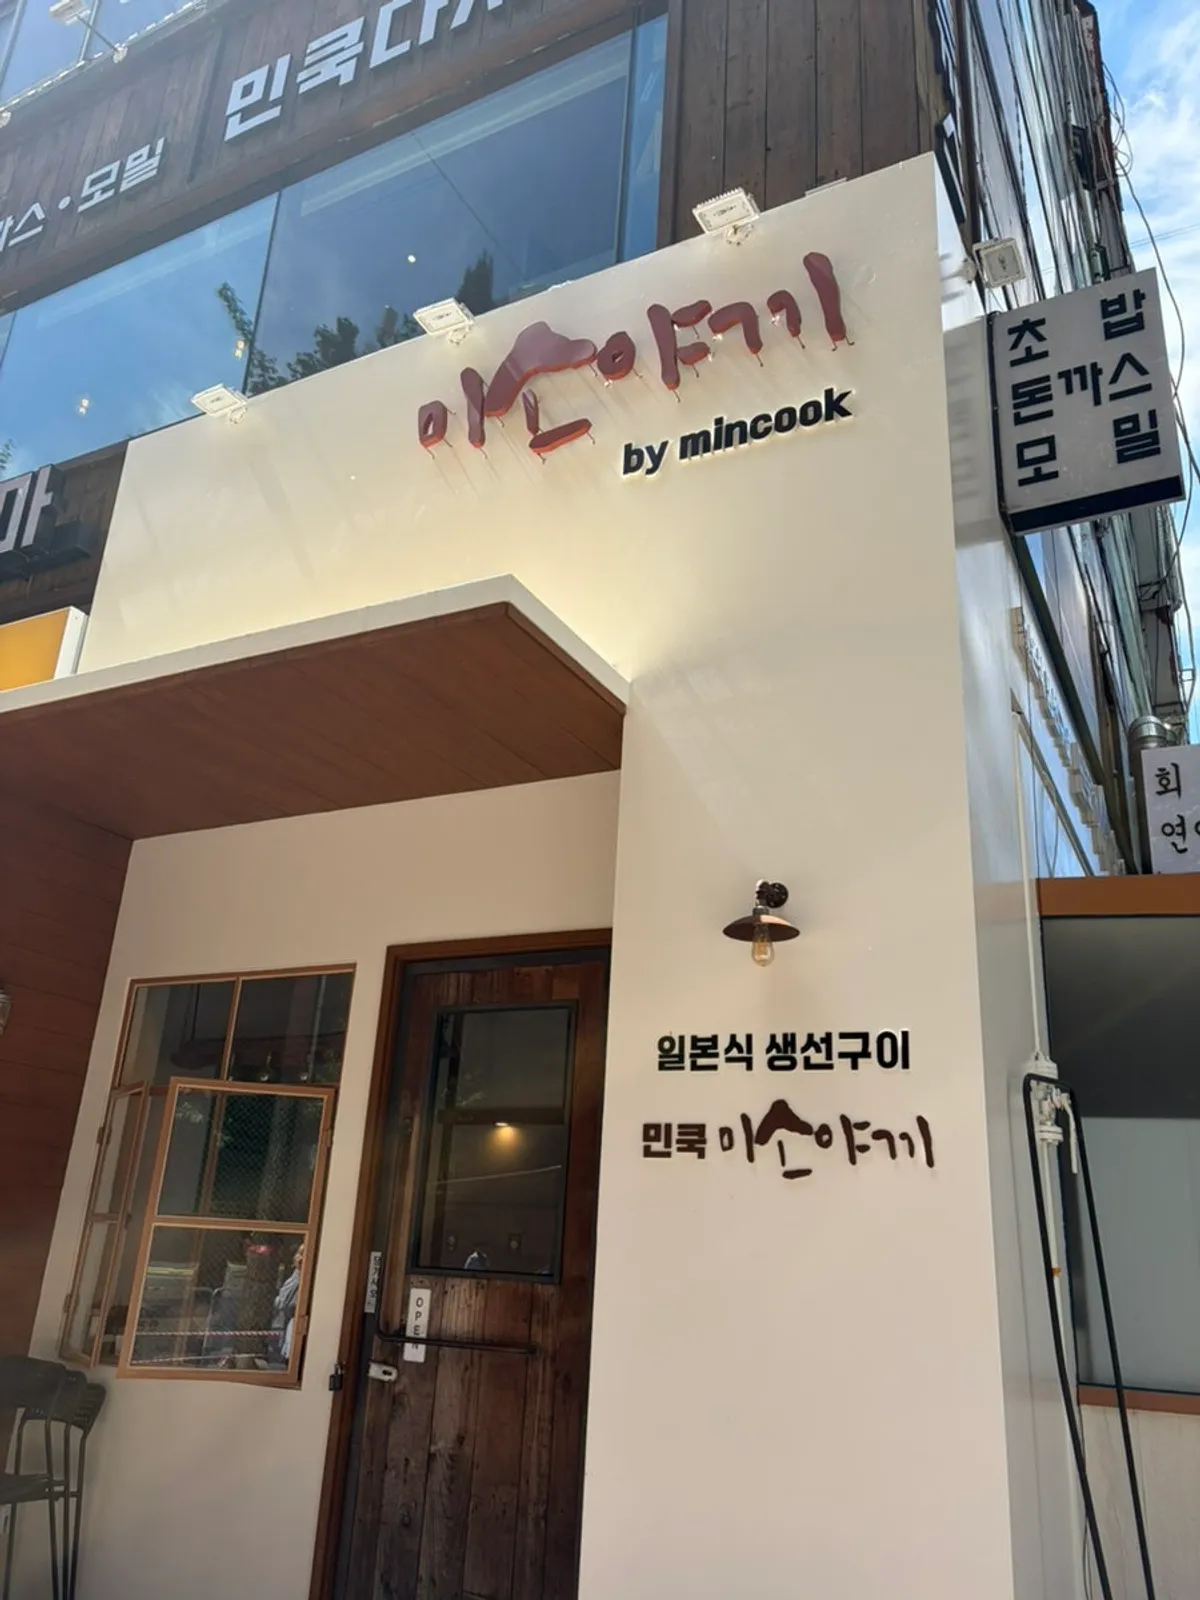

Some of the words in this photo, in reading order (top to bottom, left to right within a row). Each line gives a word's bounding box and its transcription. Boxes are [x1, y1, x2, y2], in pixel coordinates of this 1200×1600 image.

[224, 0, 503, 141] 민쿡다
[1011, 352, 1153, 427] 돈까스
[622, 442, 669, 476] by
[678, 386, 853, 461] mincook
[657, 1033, 753, 1071] 일본식
[765, 1030, 910, 1071] 생선구이
[642, 1123, 707, 1159] 민쿡
